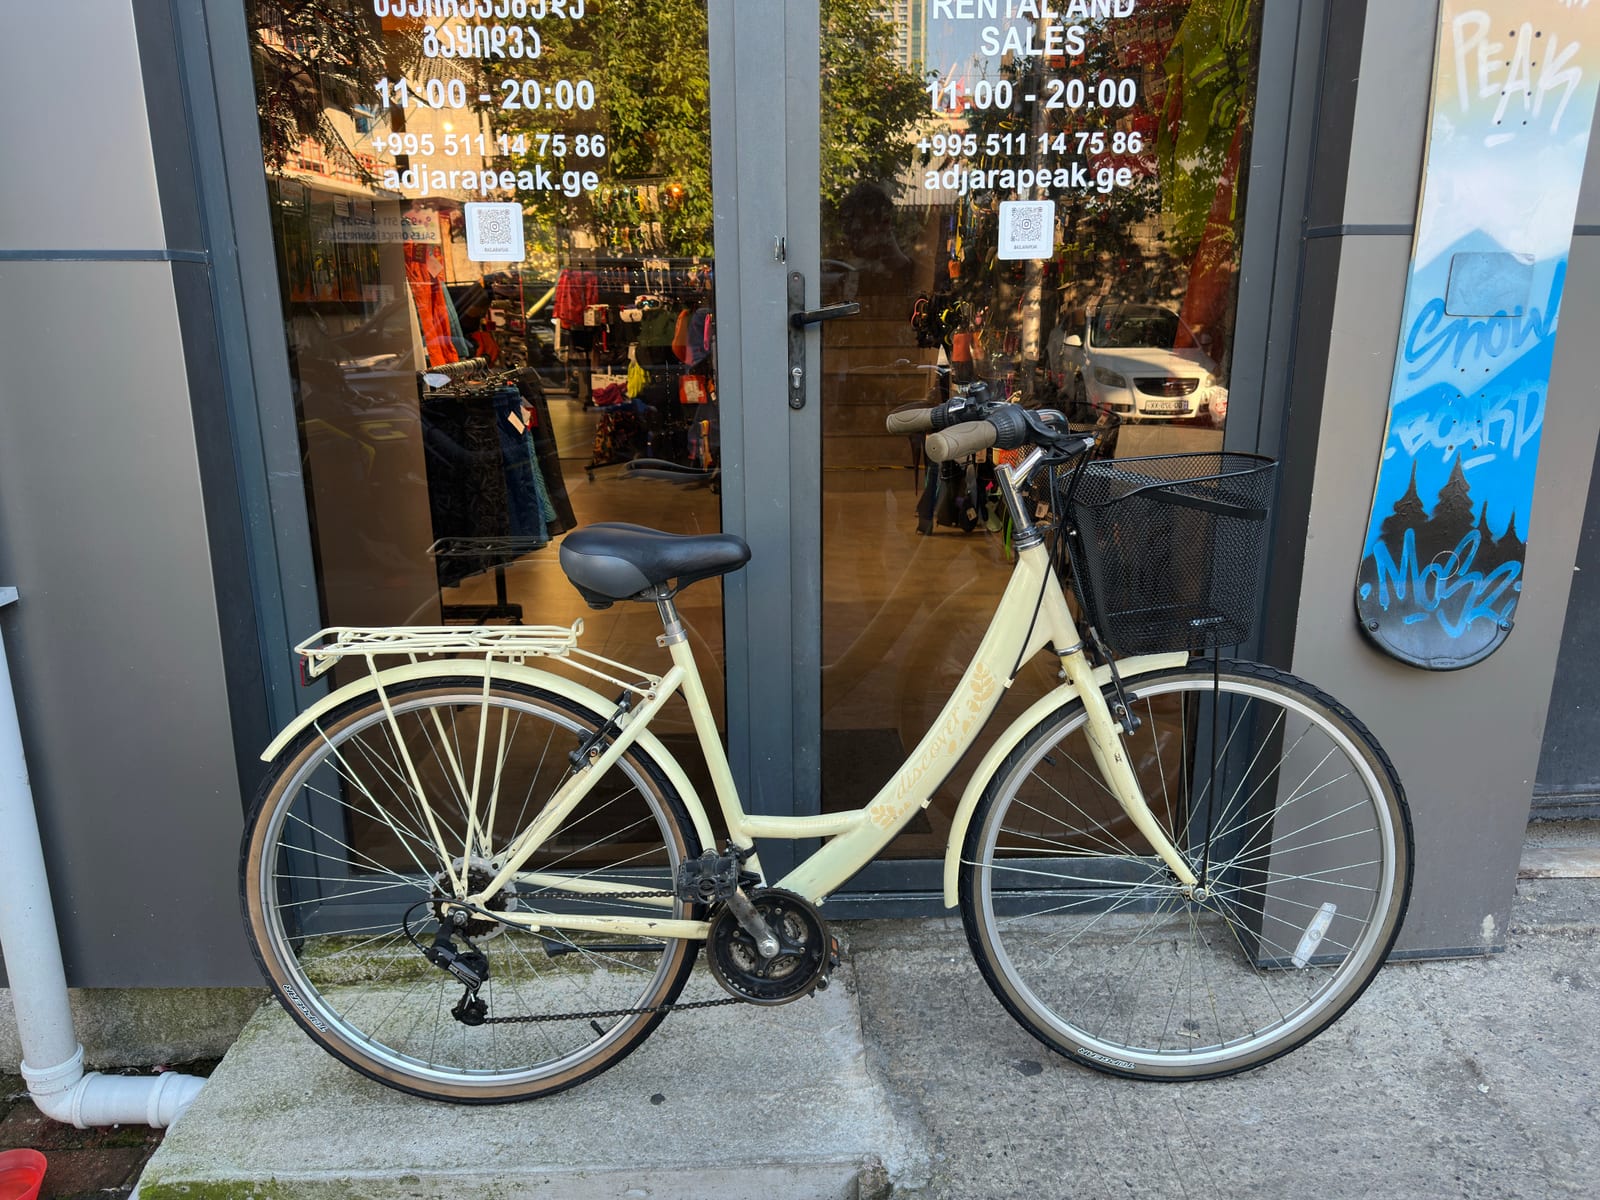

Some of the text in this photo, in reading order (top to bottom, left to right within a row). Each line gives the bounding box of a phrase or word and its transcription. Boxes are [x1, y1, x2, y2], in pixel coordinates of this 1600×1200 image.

[932, 0, 1135, 19] RENTAL AND
[423, 25, 542, 59] გაყიდვა
[980, 26, 1086, 56] SALES
[1452, 10, 1583, 136] PEAK
[374, 78, 467, 110] 11:00
[501, 79, 595, 111] 20:00
[925, 79, 1013, 110] 11:00
[1046, 78, 1137, 109] 20:00
[372, 134, 606, 158] +995 511 14 75 86
[917, 131, 1142, 157] +995 511 14 75 86
[383, 164, 600, 197] adjarapeak.ge
[923, 163, 1133, 195] adjarapeak.ge
[896, 706, 960, 800] discover
